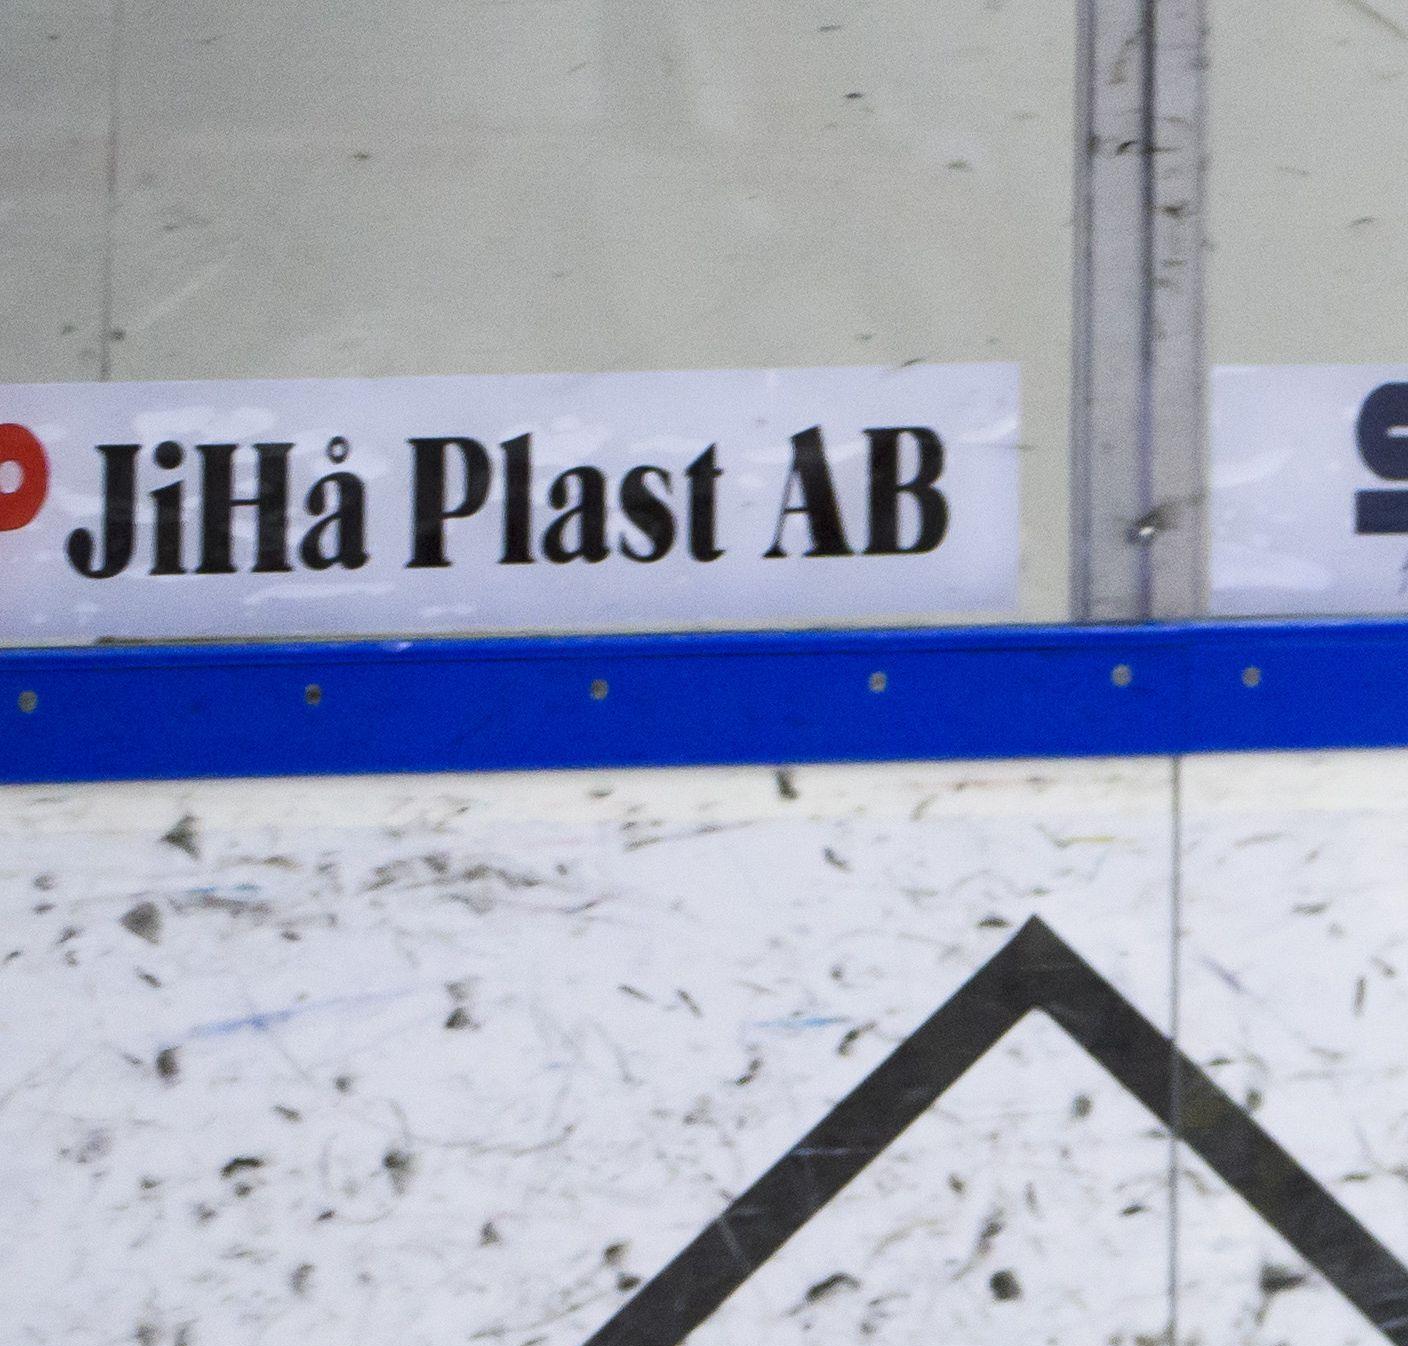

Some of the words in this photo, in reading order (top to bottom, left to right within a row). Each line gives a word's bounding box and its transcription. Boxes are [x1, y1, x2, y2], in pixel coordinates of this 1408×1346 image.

[66, 436, 370, 580] JiHå
[404, 432, 727, 569] Plast
[762, 424, 951, 560] AB
